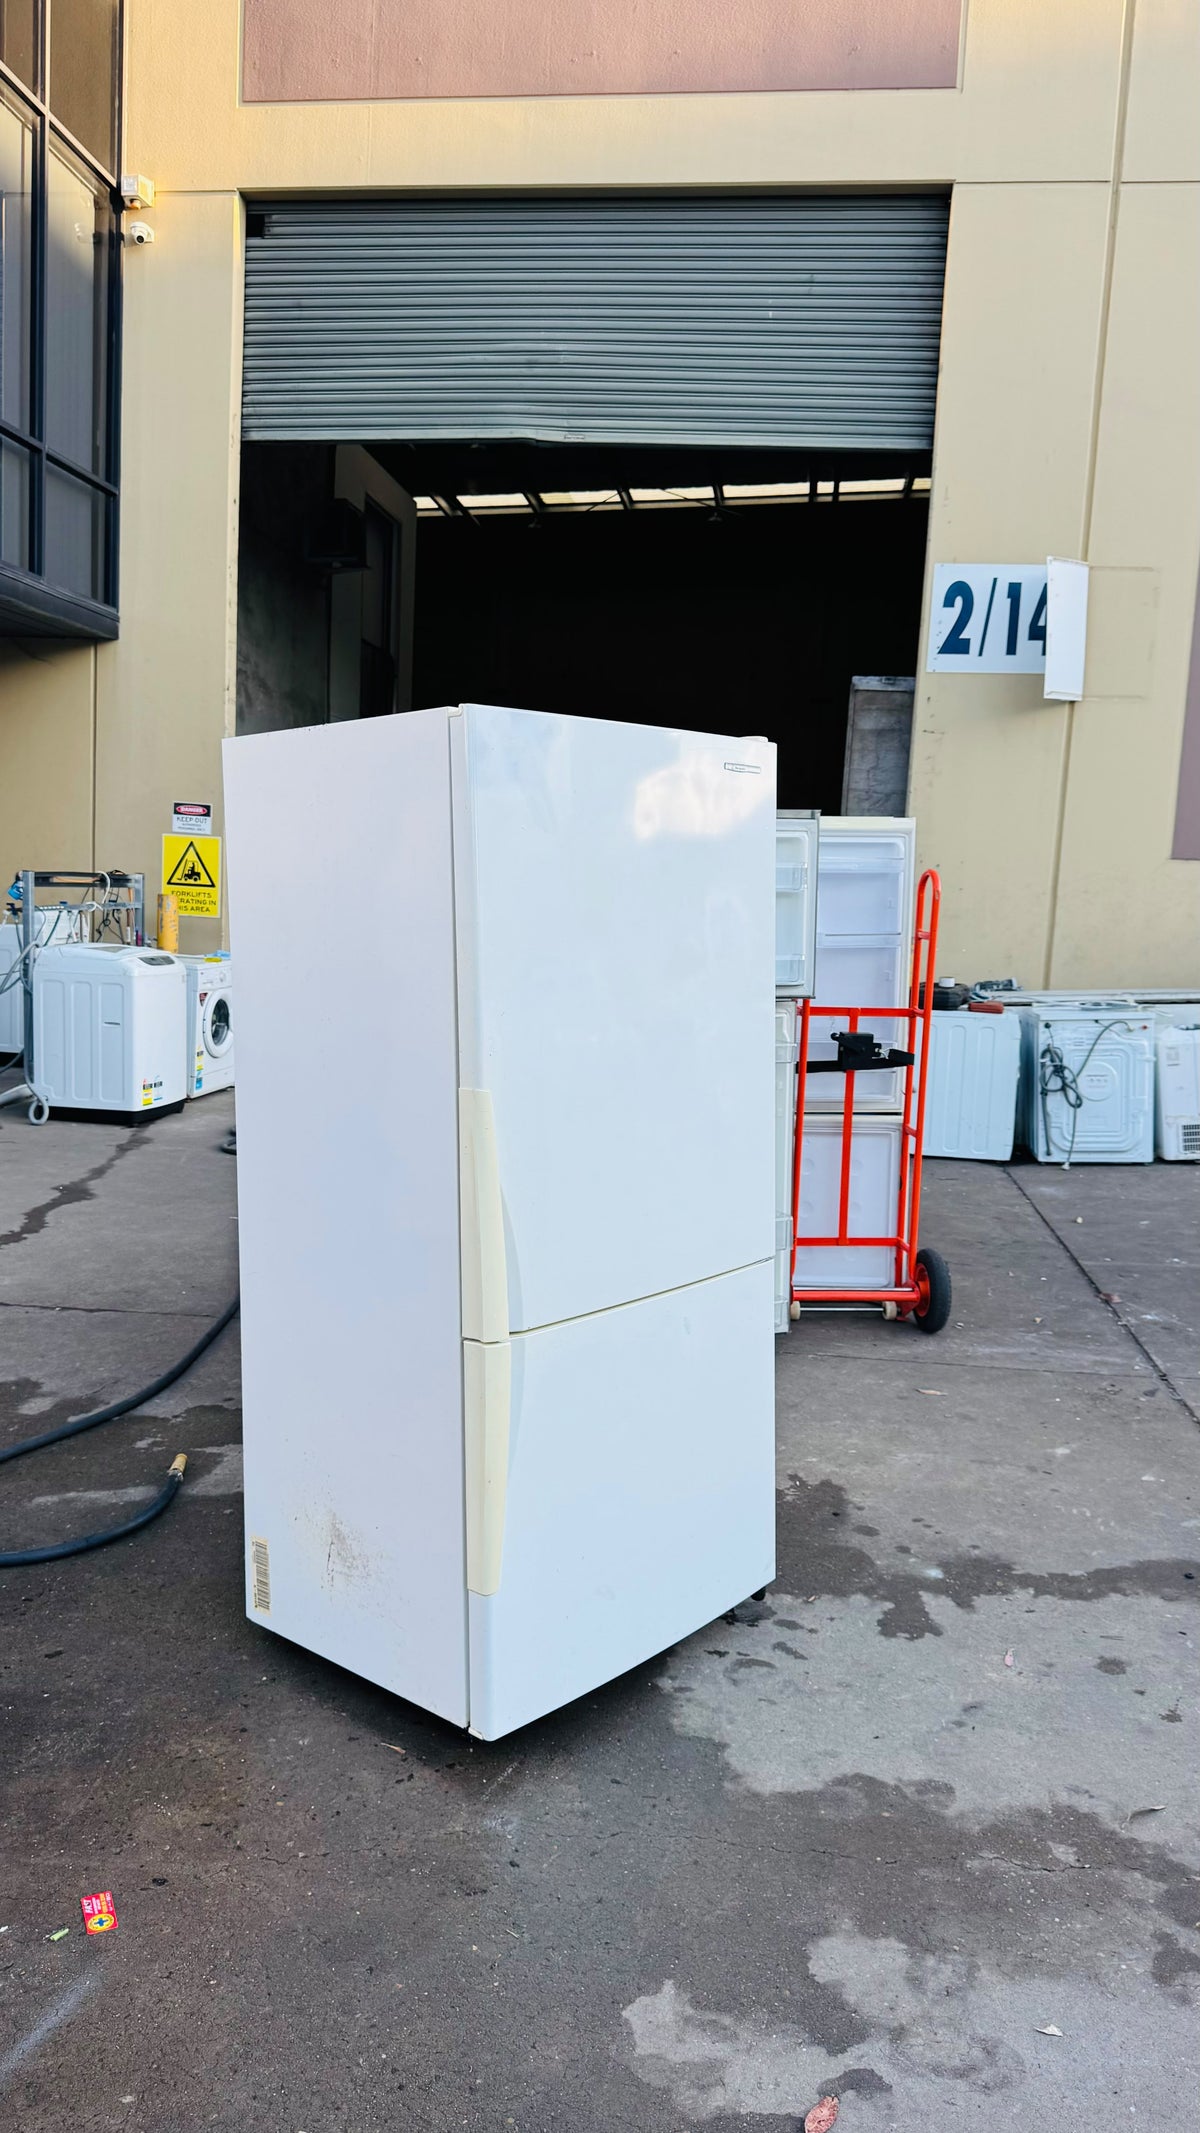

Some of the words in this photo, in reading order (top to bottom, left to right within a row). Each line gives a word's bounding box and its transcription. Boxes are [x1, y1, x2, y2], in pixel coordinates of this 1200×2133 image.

[937, 577, 1047, 657] 2/14
[171, 890, 212, 898] FORKLIFTS
[179, 897, 207, 905] RATING
